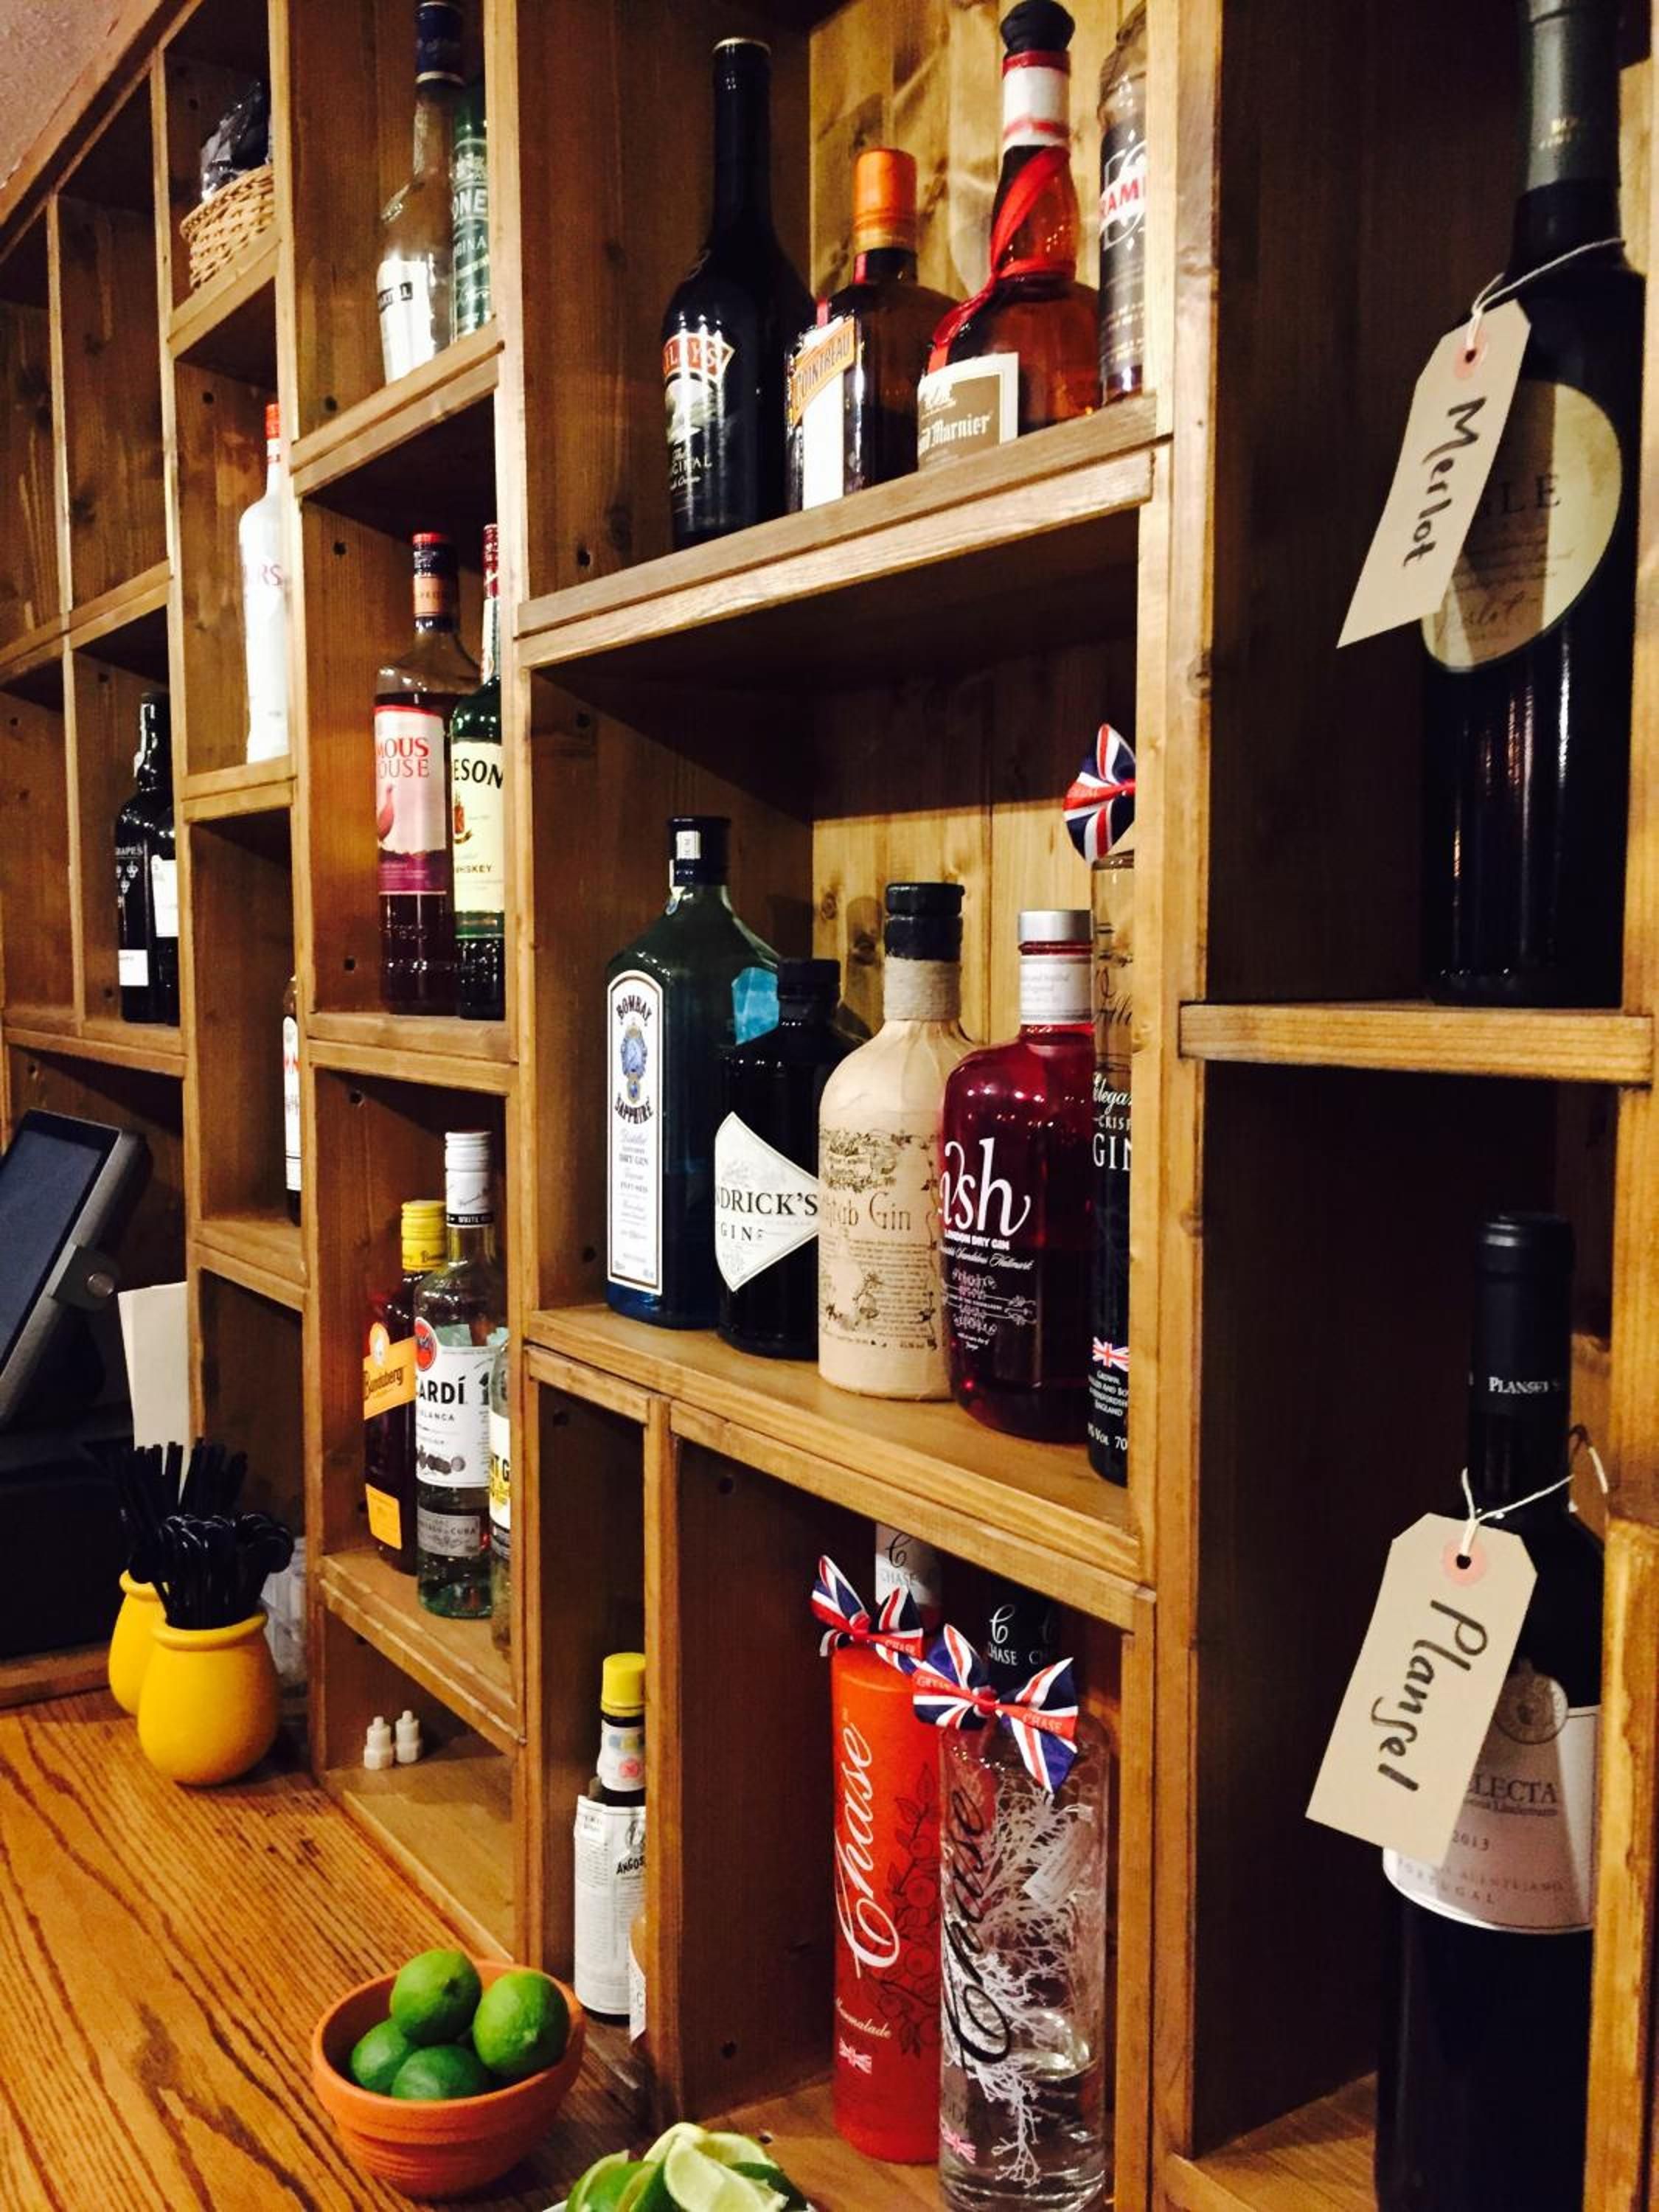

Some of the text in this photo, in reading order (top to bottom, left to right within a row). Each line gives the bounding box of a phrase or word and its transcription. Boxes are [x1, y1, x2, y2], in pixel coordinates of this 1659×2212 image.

[1402, 396, 1487, 568] Merlot
[616, 995, 653, 1022] BOMBAY
[614, 1096, 654, 1125] SAPPHIRE
[869, 1191, 911, 1231] Gin
[971, 1235, 990, 1248] DRY
[991, 1238, 1010, 1251] GIN
[1023, 1712, 1062, 1731] CHASE
[1470, 1773, 1557, 1804] LECTA
[835, 1719, 900, 1980] Chase
[1453, 1829, 1489, 1851] 2013
